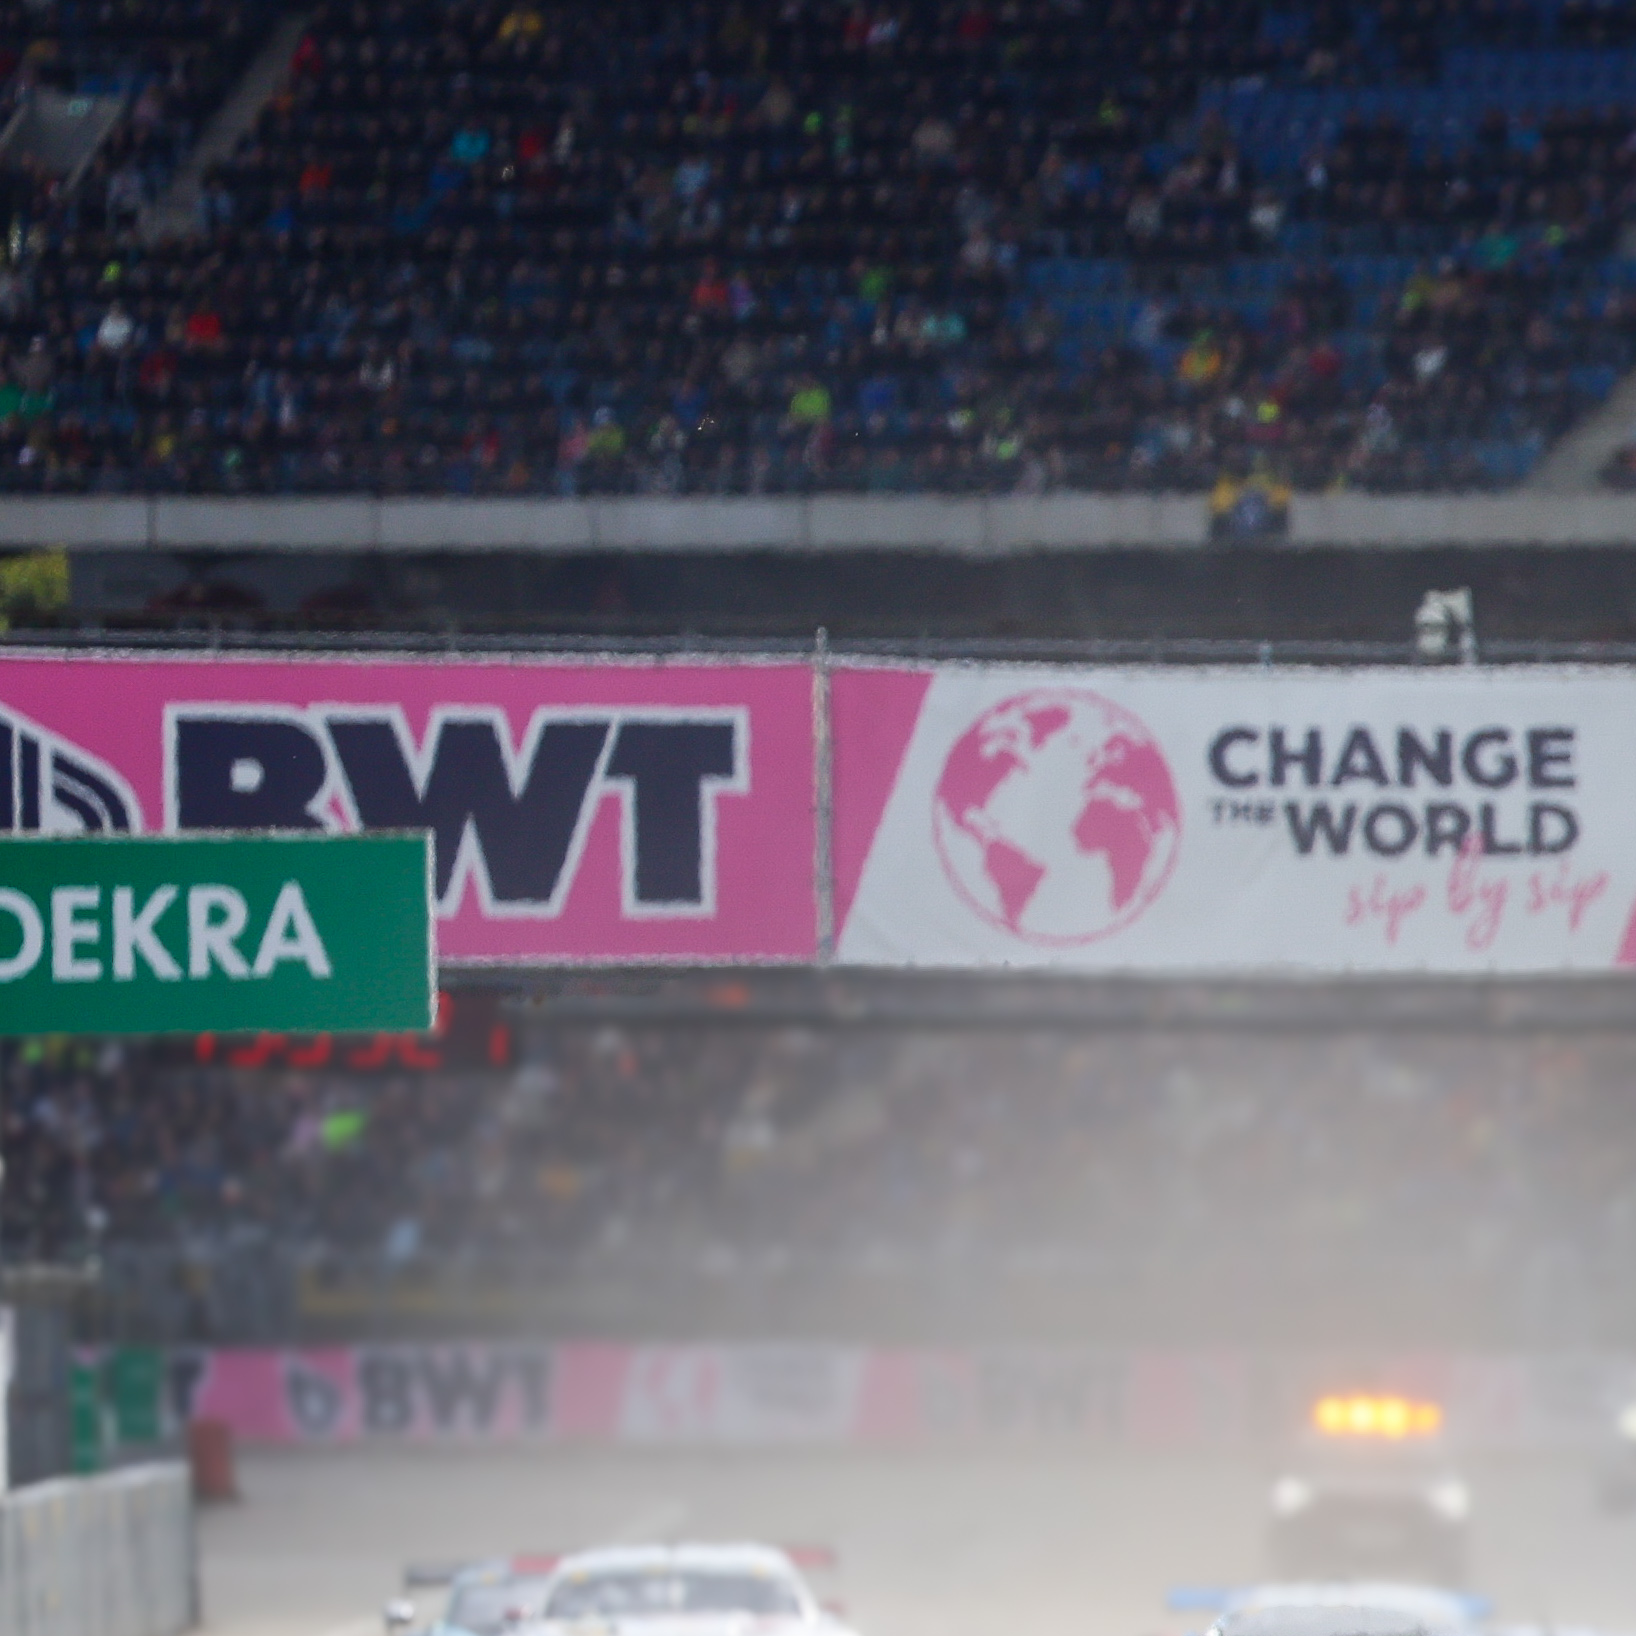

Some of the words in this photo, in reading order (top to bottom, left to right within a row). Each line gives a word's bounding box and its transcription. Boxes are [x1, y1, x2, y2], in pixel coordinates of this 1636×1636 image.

[1208, 726, 1577, 788] CHANGE
[1210, 800, 1275, 825] THE
[1282, 804, 1580, 860] WORLD
[355, 1345, 558, 1436] BWT
